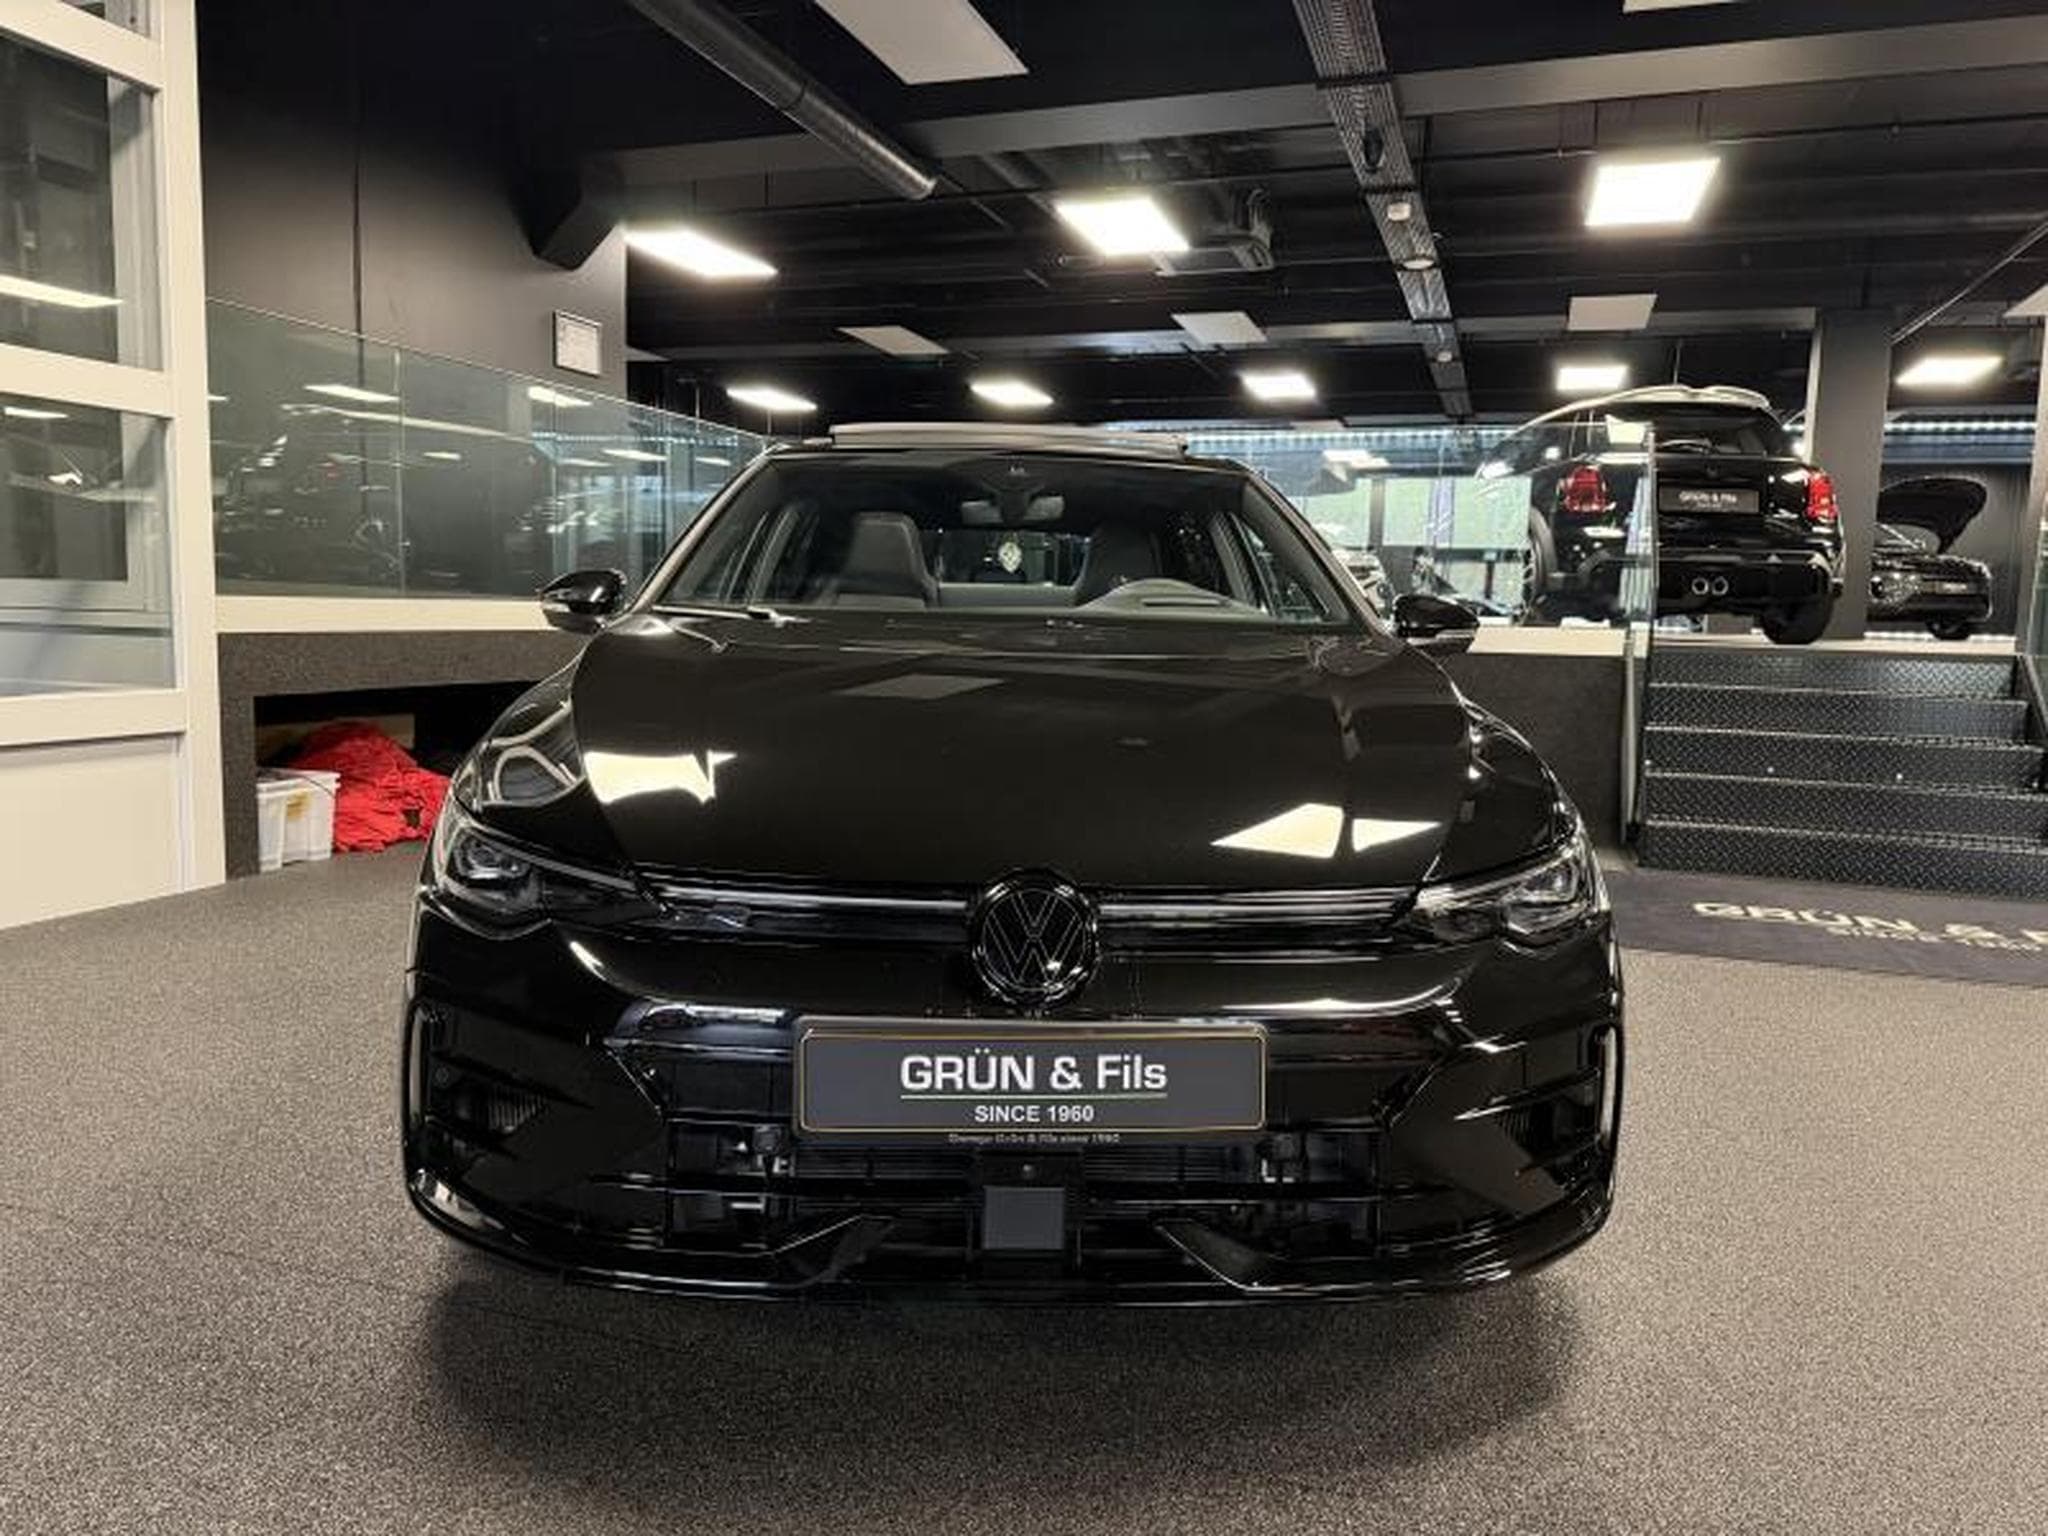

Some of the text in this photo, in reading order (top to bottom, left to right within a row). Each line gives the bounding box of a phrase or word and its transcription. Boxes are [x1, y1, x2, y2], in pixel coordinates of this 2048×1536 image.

[900, 1047, 1169, 1091] GRÜN & Fils
[974, 1104, 1095, 1123] SINCE 1960
